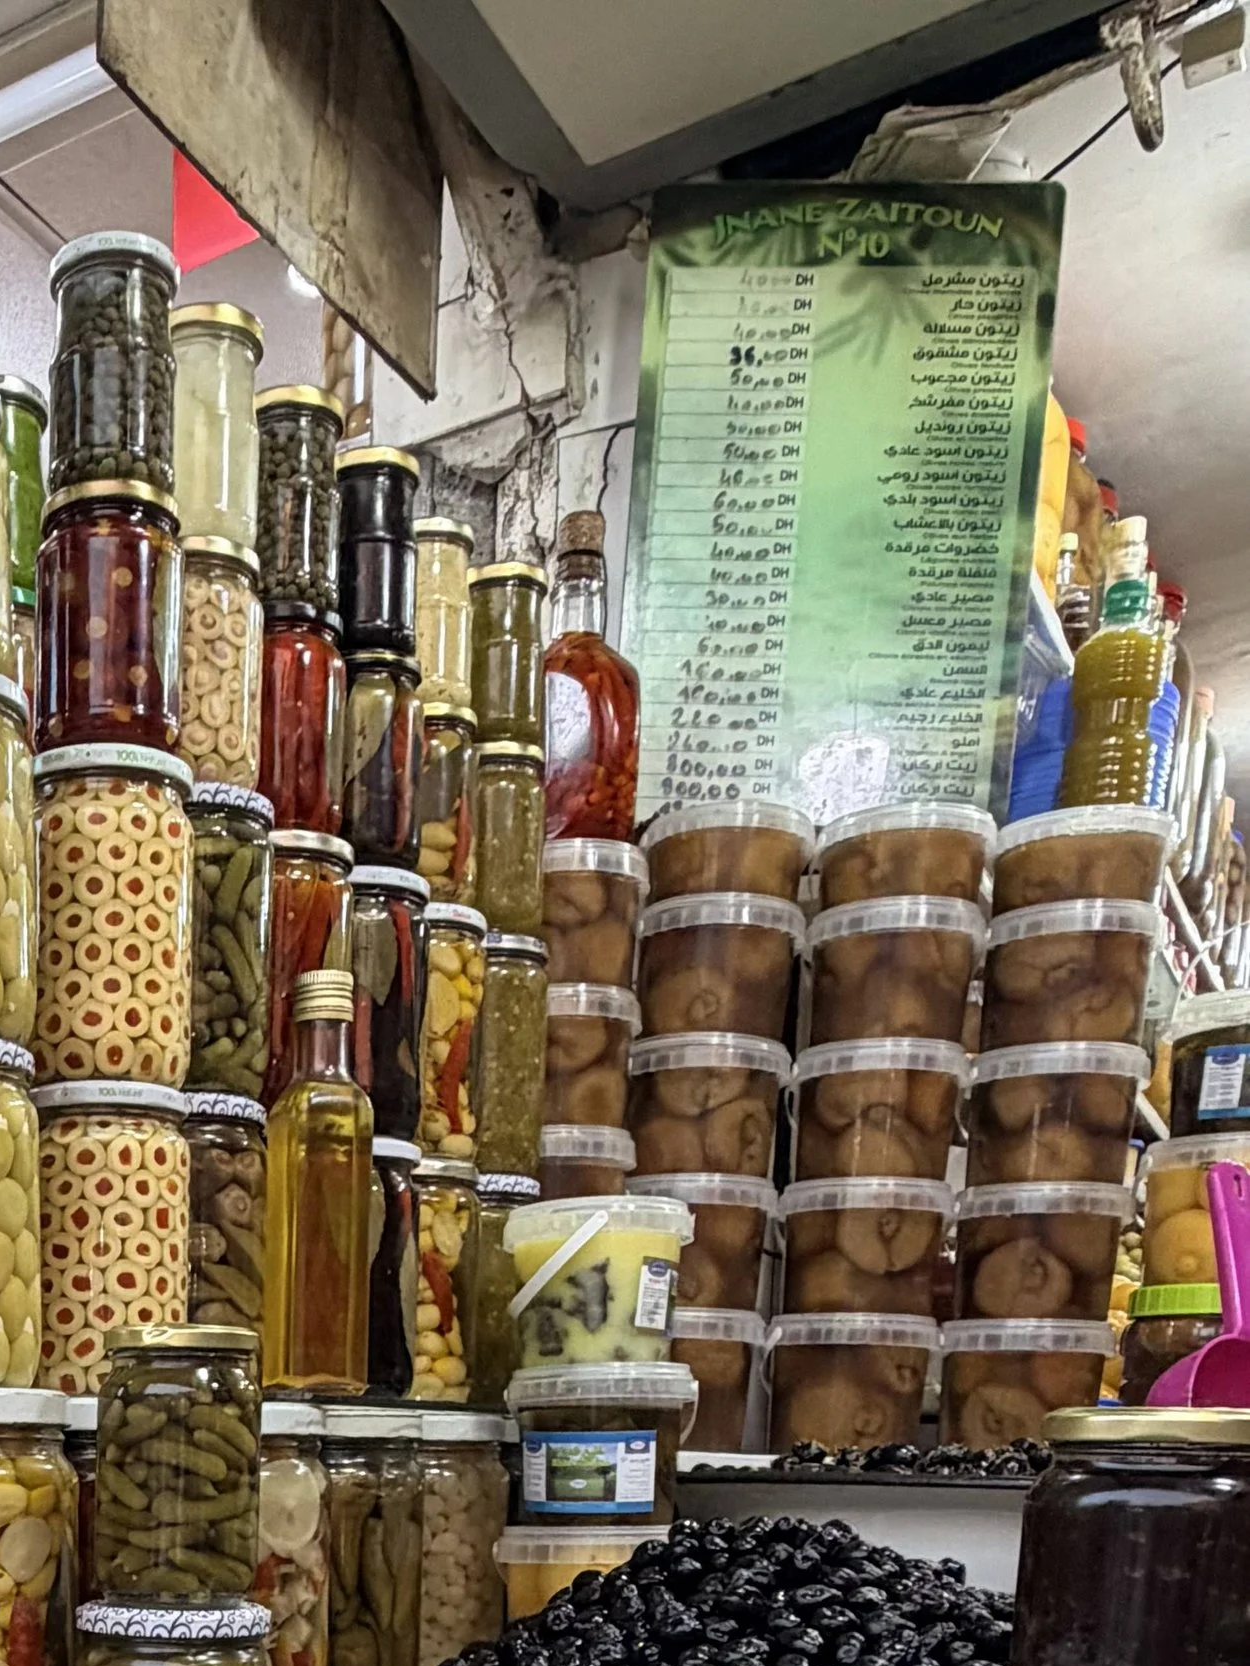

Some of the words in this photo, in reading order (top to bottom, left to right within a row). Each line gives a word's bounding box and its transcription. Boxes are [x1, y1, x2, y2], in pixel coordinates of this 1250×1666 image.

[712, 203, 823, 245] JNANE
[840, 200, 1004, 238] ZAITOUN
[795, 273, 814, 286] DH
[922, 271, 976, 288] مشرمل
[979, 272, 1024, 288] زيتون
[793, 298, 812, 311] DH
[951, 298, 974, 312] حار
[977, 298, 1022, 312] زيتون
[791, 322, 810, 335] DH
[975, 321, 1020, 337] زيتون
[790, 347, 808, 360] DH
[973, 347, 1017, 361] زيتون
[787, 371, 806, 384] DH
[971, 371, 1015, 385] زيتون
[785, 396, 804, 409] DH
[968, 396, 1013, 410] زيتون
[783, 420, 802, 433] DH
[966, 420, 1011, 434] زيتون
[781, 445, 800, 457] DH
[964, 445, 1008, 459] زيتون
[779, 469, 798, 482] DH
[962, 469, 1006, 483] زيتون
[777, 494, 796, 506] DH
[960, 494, 1004, 508] زيتون
[775, 518, 794, 530] DH
[957, 519, 1001, 532] زيتون
[773, 542, 791, 554] DH
[771, 567, 789, 579] DH
[769, 591, 787, 603] DH
[767, 614, 786, 627] DH
[765, 639, 783, 651] DH
[763, 663, 781, 675] DH
[760, 687, 779, 699] DH
[758, 711, 777, 722] DH
[756, 734, 775, 747] DH
[754, 759, 773, 770] DH
[752, 782, 771, 794] DH
